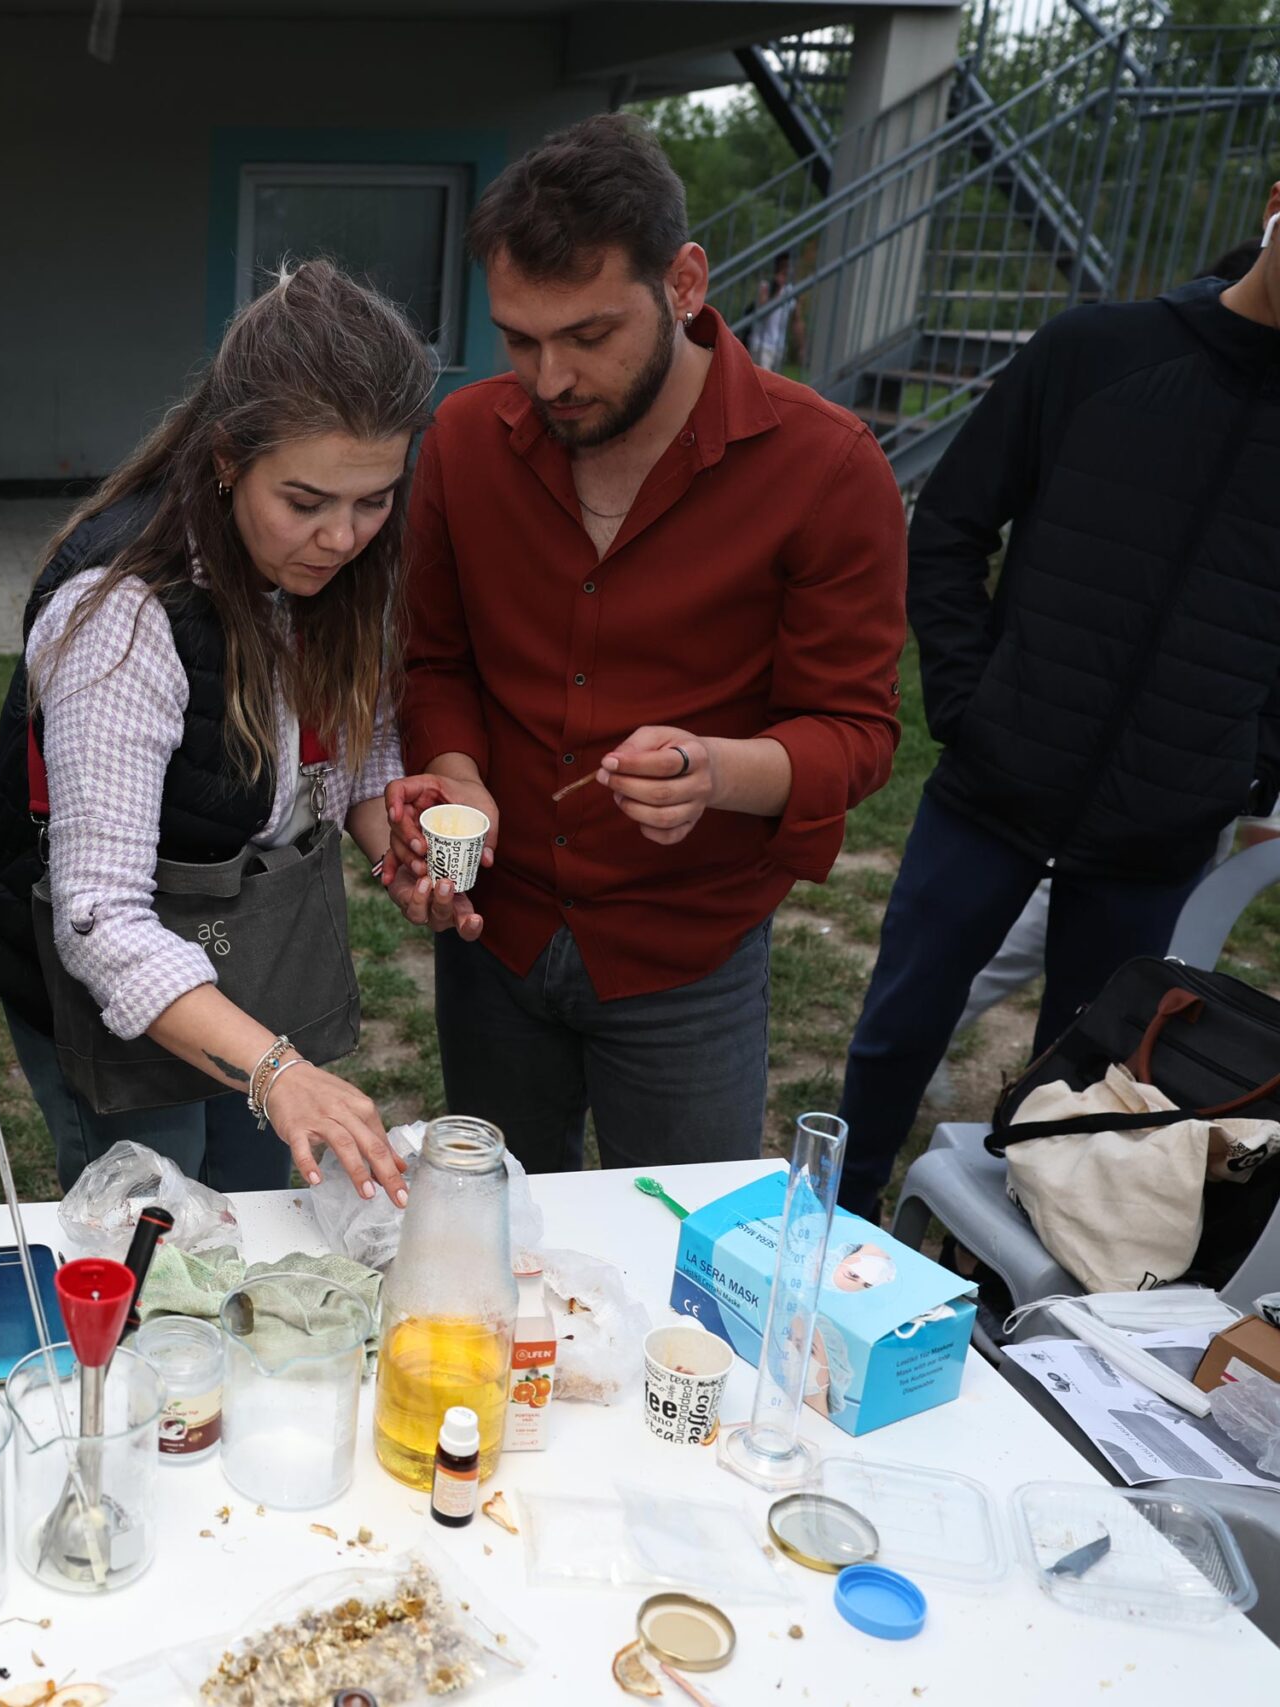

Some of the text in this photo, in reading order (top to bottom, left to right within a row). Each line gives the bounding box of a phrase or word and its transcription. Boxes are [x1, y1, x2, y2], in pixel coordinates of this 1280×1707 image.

[433, 850, 450, 881] coff
[198, 920, 227, 940] ac
[686, 1249, 760, 1308] LA SERA MASK
[650, 1420, 675, 1442] tea
[688, 1395, 710, 1445] coffee
